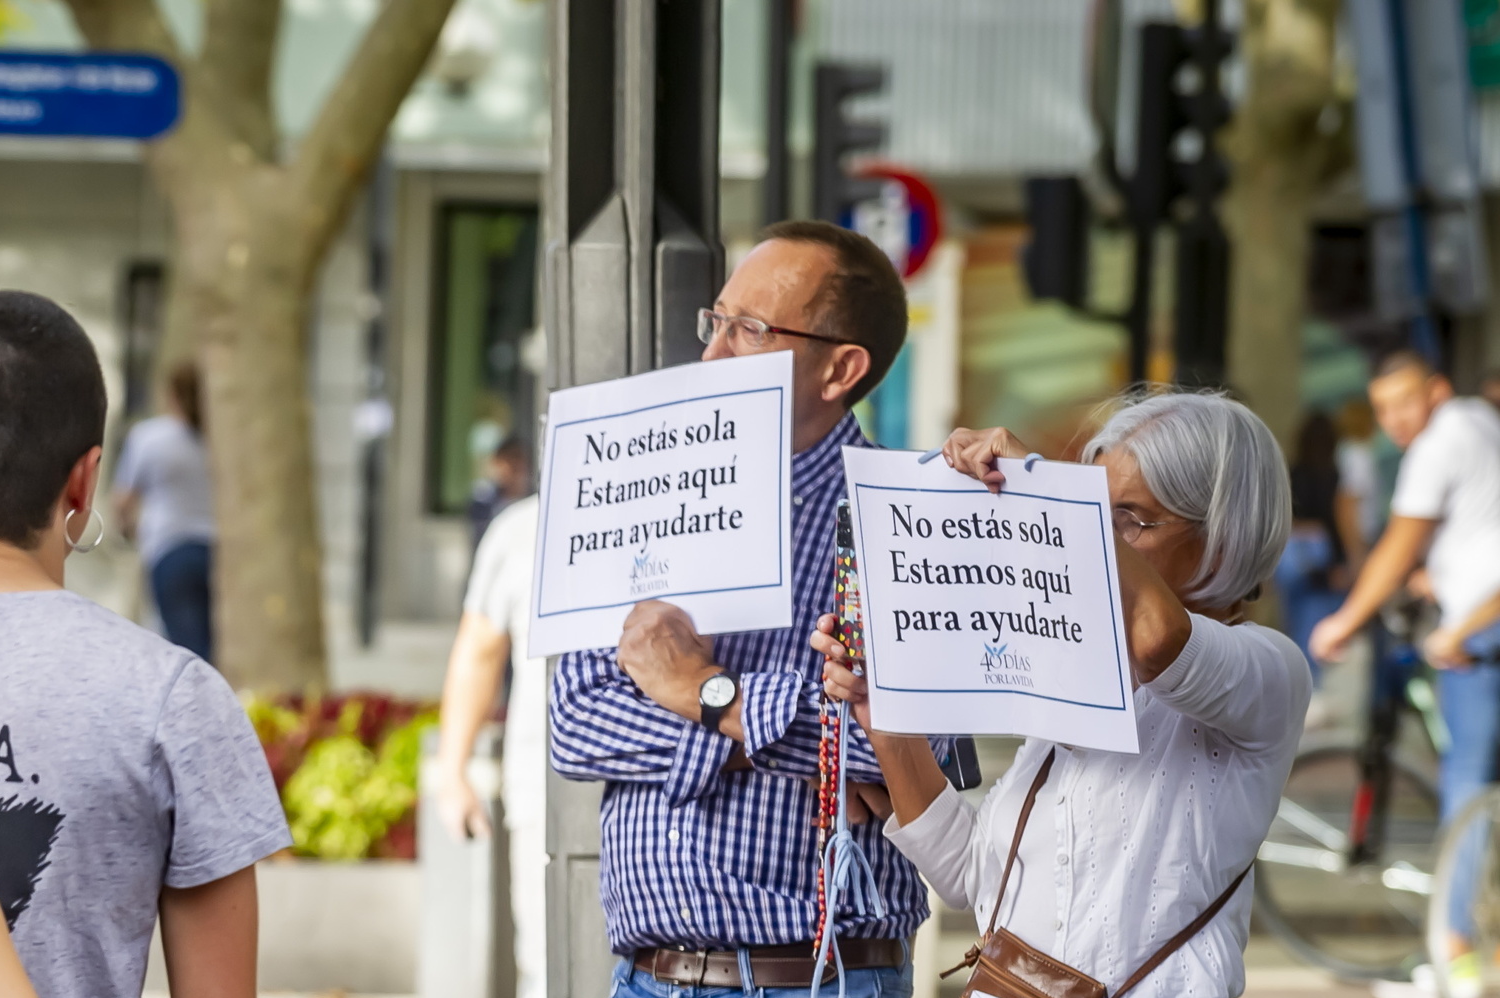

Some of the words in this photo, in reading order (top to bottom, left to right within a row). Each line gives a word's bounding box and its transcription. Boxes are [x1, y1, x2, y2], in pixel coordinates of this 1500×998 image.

[583, 431, 621, 465] No
[627, 420, 678, 458] estás
[684, 408, 737, 446] sola
[574, 472, 671, 510] Estamos
[677, 454, 738, 500] aquí
[567, 527, 624, 566] para
[629, 502, 743, 554] ayudarte
[888, 503, 933, 539] No
[941, 508, 1013, 540] estás
[1018, 511, 1065, 548] sola
[888, 549, 1016, 586] Estamos
[1021, 564, 1073, 604] aquí
[892, 608, 963, 643] para
[970, 601, 1083, 644] ayudarte
[980, 651, 1002, 671] 40
[1003, 649, 1032, 672] DÍAS
